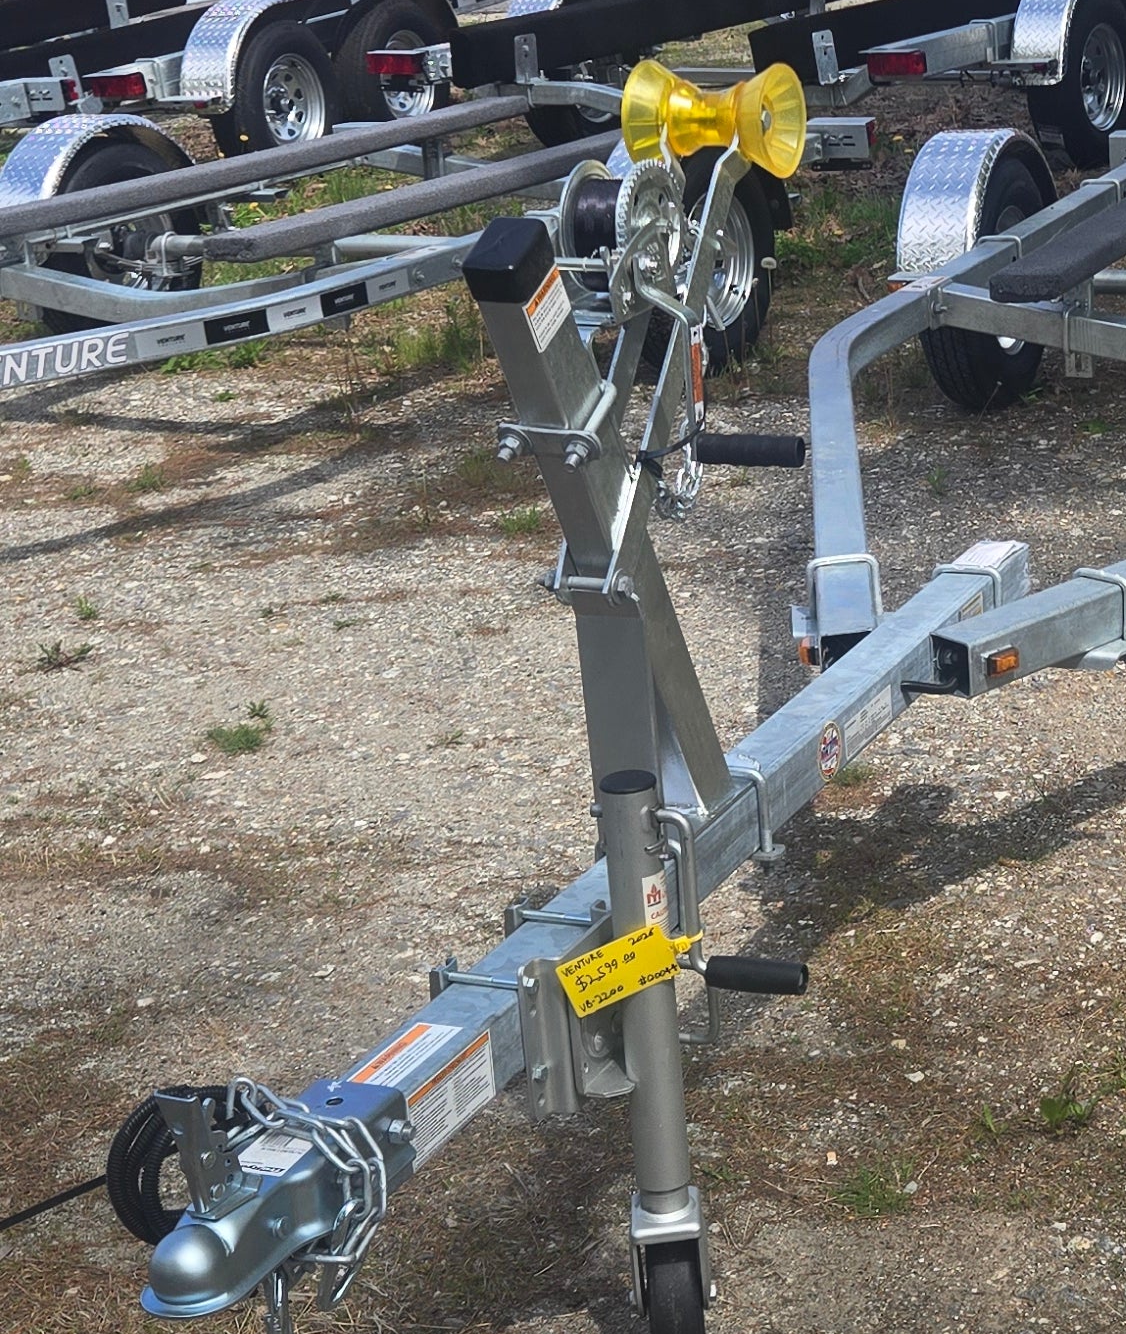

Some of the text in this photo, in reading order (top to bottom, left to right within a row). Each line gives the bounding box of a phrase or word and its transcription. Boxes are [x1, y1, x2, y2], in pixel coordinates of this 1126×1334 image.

[0, 331, 130, 385] NTURE
[561, 950, 604, 977] VENTURE
[579, 985, 624, 1012] VB-2200
